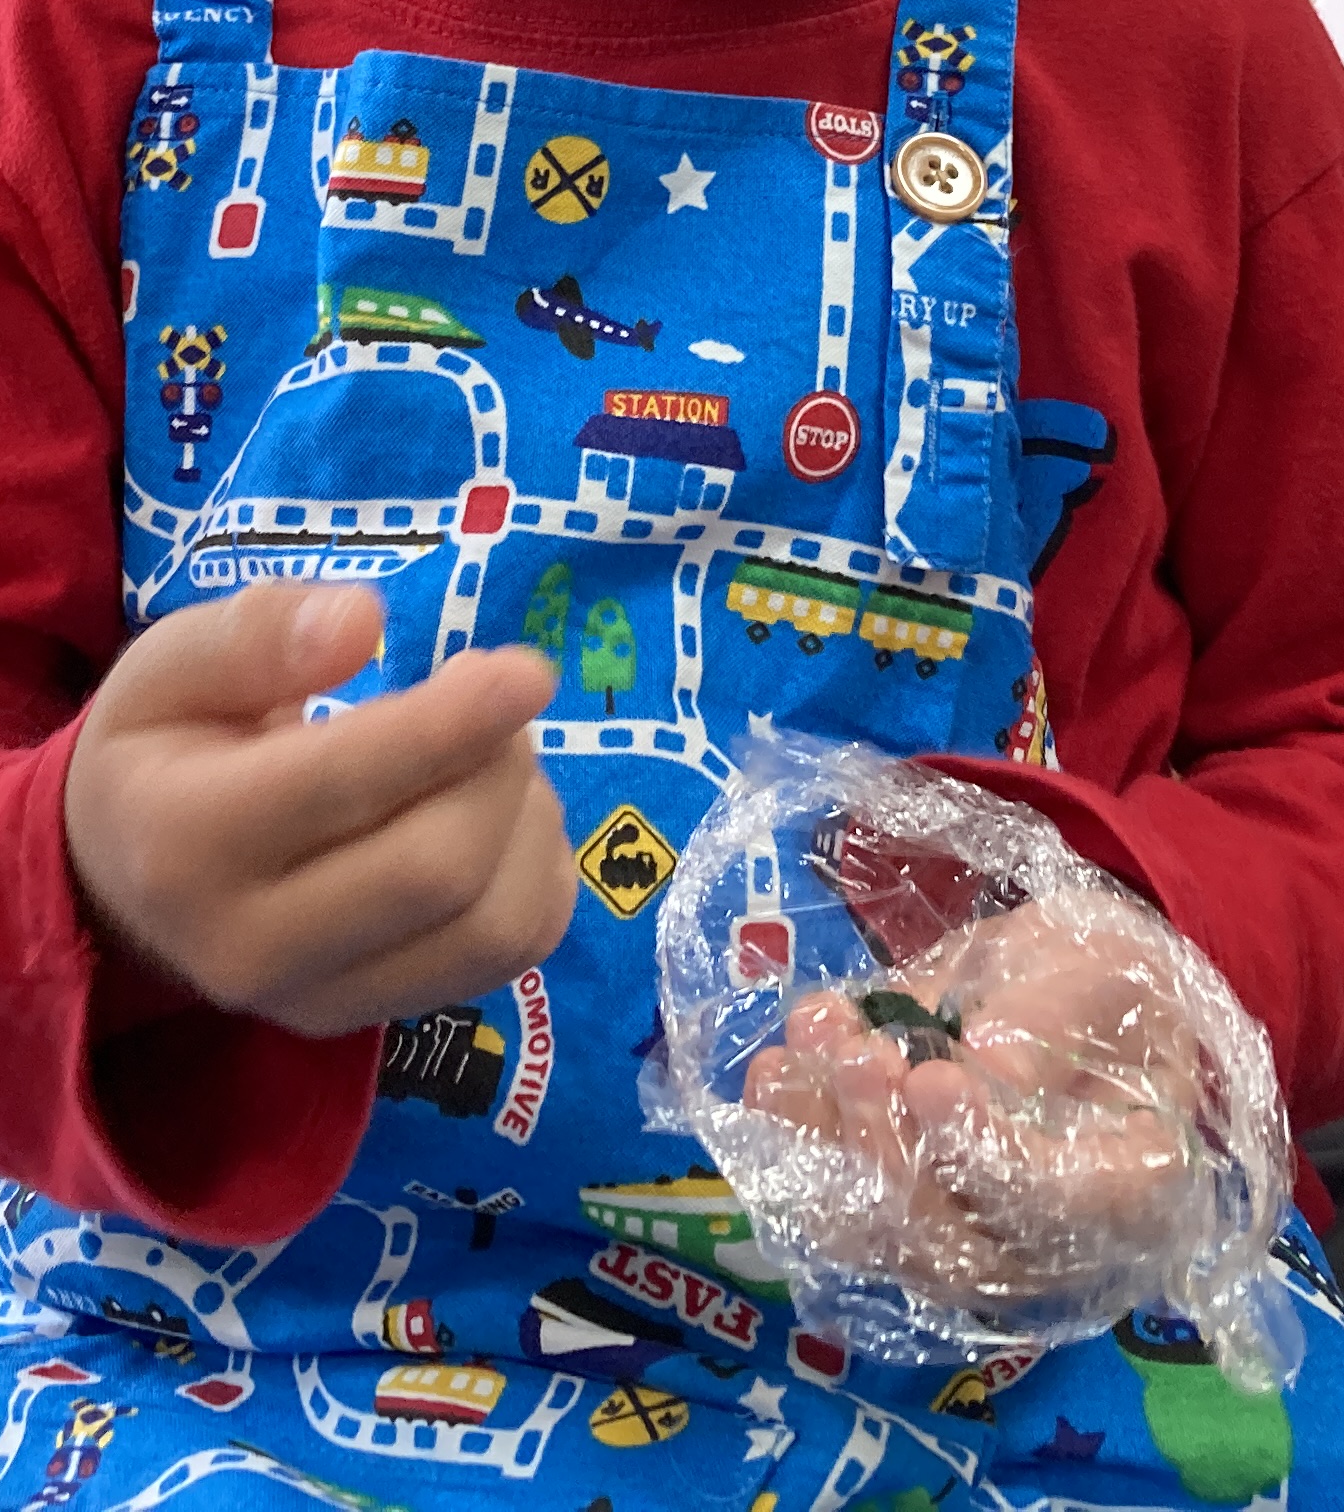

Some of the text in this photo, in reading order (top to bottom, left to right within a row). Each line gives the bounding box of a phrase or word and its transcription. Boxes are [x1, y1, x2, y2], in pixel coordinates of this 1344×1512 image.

[818, 112, 873, 138] STOP
[943, 300, 977, 328] UP
[612, 393, 719, 426] STATION
[796, 425, 850, 451] STOP
[502, 970, 552, 1139] OMOTIVE
[598, 1244, 760, 1343] FAST
